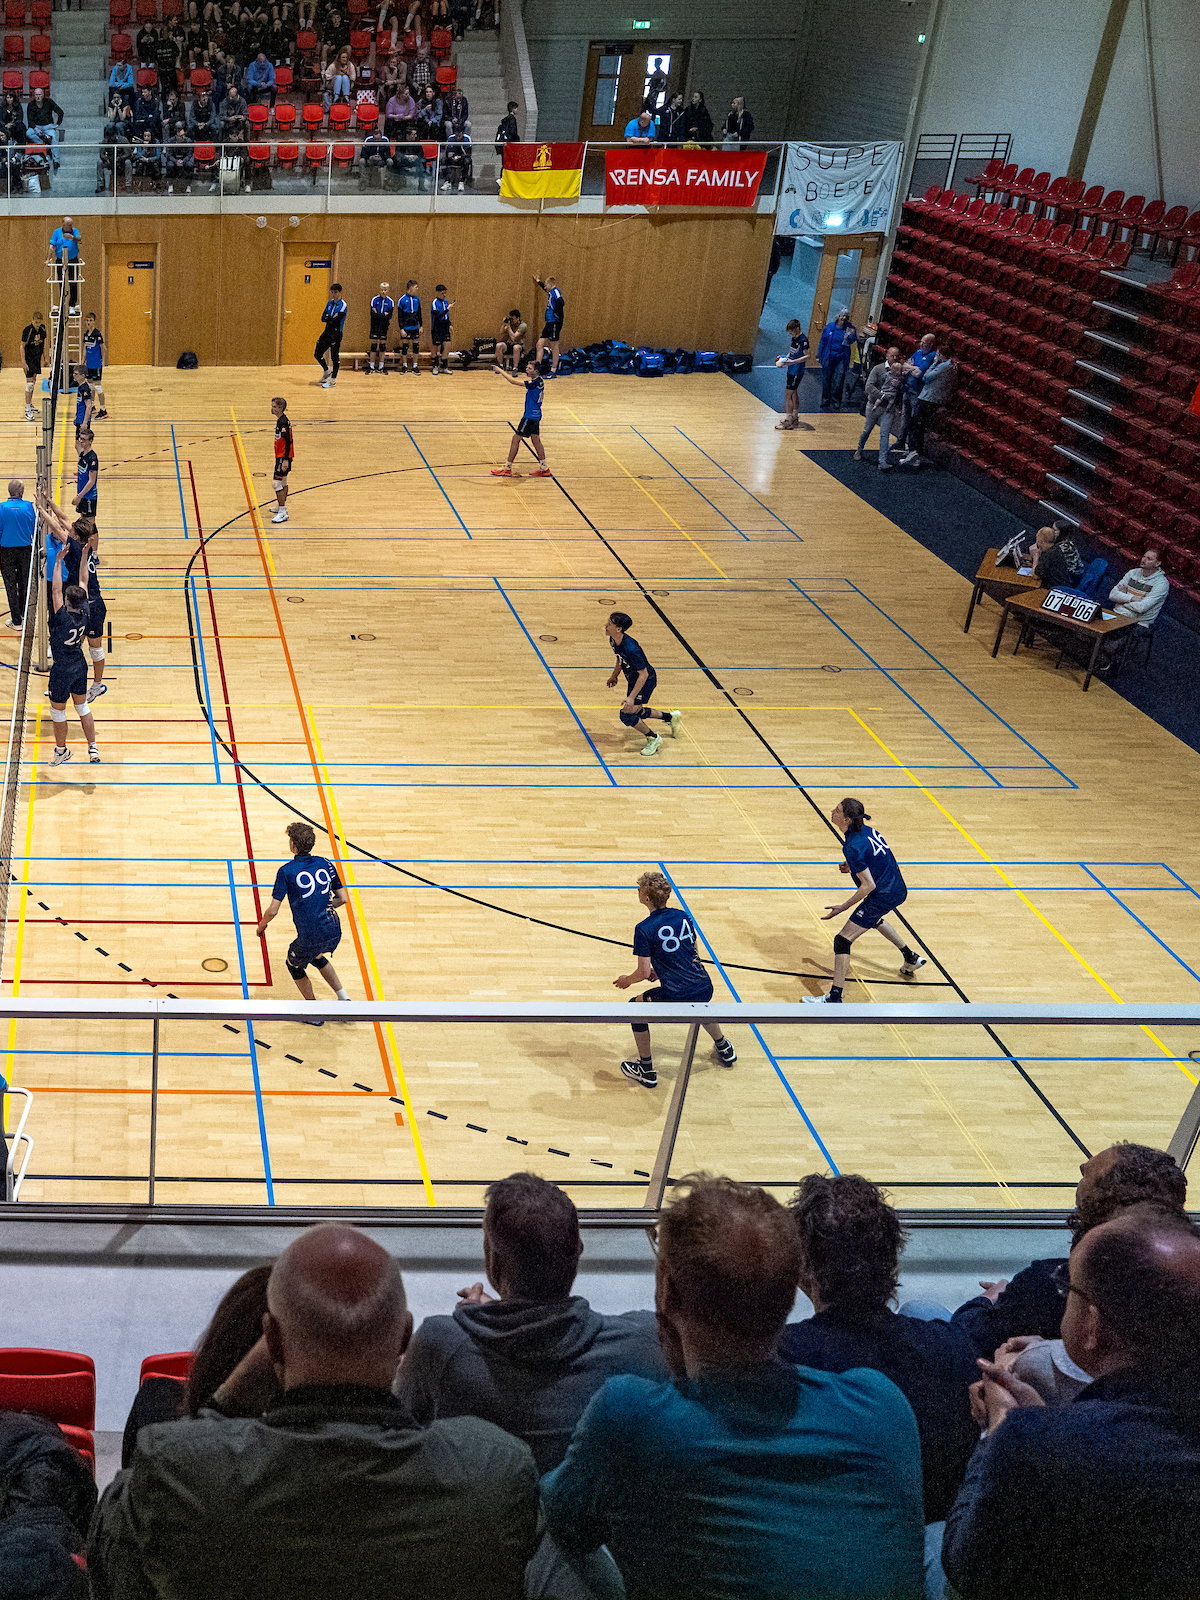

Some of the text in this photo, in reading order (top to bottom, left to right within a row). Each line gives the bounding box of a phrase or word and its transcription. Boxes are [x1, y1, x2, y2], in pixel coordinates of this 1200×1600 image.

[609, 168, 760, 188] RENSA FAMILY
[805, 180, 894, 201] BOEREN
[1045, 595, 1063, 609] 07
[1075, 605, 1093, 619] 06
[867, 827, 890, 857] 46
[296, 868, 331, 899] 99
[657, 918, 695, 953] 84
